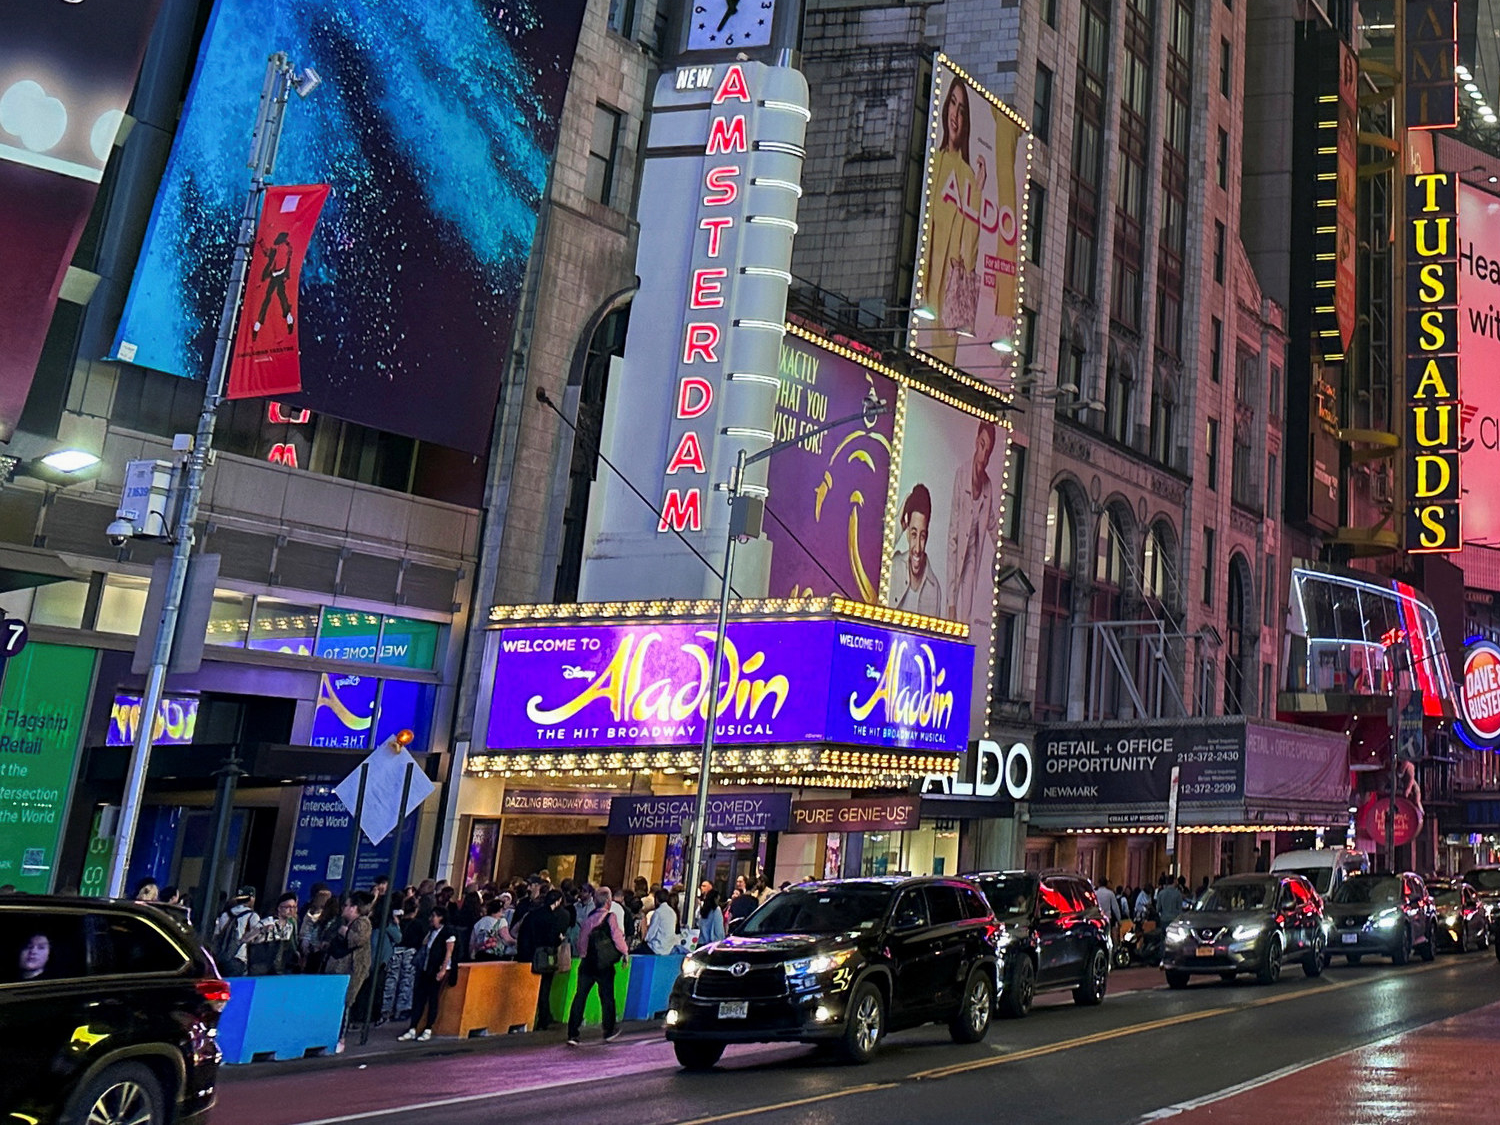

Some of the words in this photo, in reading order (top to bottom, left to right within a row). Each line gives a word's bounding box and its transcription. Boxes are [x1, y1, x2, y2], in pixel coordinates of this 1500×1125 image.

[761, 1, 772, 9] 3
[726, 34, 734, 45] 6
[676, 68, 712, 89] NEW
[941, 169, 1017, 245] ALDO
[657, 64, 750, 532] AMSTERDAM
[780, 344, 819, 385] XACTLY
[1413, 173, 1453, 549] TUSSAUD'S
[807, 390, 828, 423] YOU
[6, 625, 24, 650] 7
[503, 639, 576, 653] WELCOME
[581, 638, 600, 650] TO
[839, 634, 873, 650] WELCOME
[875, 640, 884, 652] TO
[526, 631, 790, 725] Aladdin
[562, 665, 596, 682] Disney
[1466, 665, 1494, 698] DAVE
[850, 638, 953, 730] Aladdin
[6, 709, 68, 732] Flagship
[537, 729, 565, 740] THE
[573, 728, 599, 738] HIT
[607, 726, 696, 738] BROADWAY
[716, 724, 773, 736] USICAL
[853, 726, 866, 736] THE
[869, 727, 880, 737] HIT
[883, 728, 918, 741] BROADWAY
[920, 730, 946, 744] MUSICAL
[0, 736, 42, 754] Retail
[1047, 740, 1098, 756] RETAIL
[1117, 738, 1173, 753] OFFICE
[1046, 756, 1156, 774] OPPORTUNITY
[1177, 751, 1239, 762] 212-372-2430
[8, 763, 27, 776] the
[1043, 786, 1098, 798] NEWMARK
[505, 798, 541, 808] DAZZLING
[542, 798, 583, 810] BROADWAY
[584, 799, 598, 809] ONE
[706, 800, 763, 813] COMEDY
[21, 810, 54, 823] World
[300, 816, 309, 827] of
[310, 817, 324, 827] the
[326, 816, 348, 827] World
